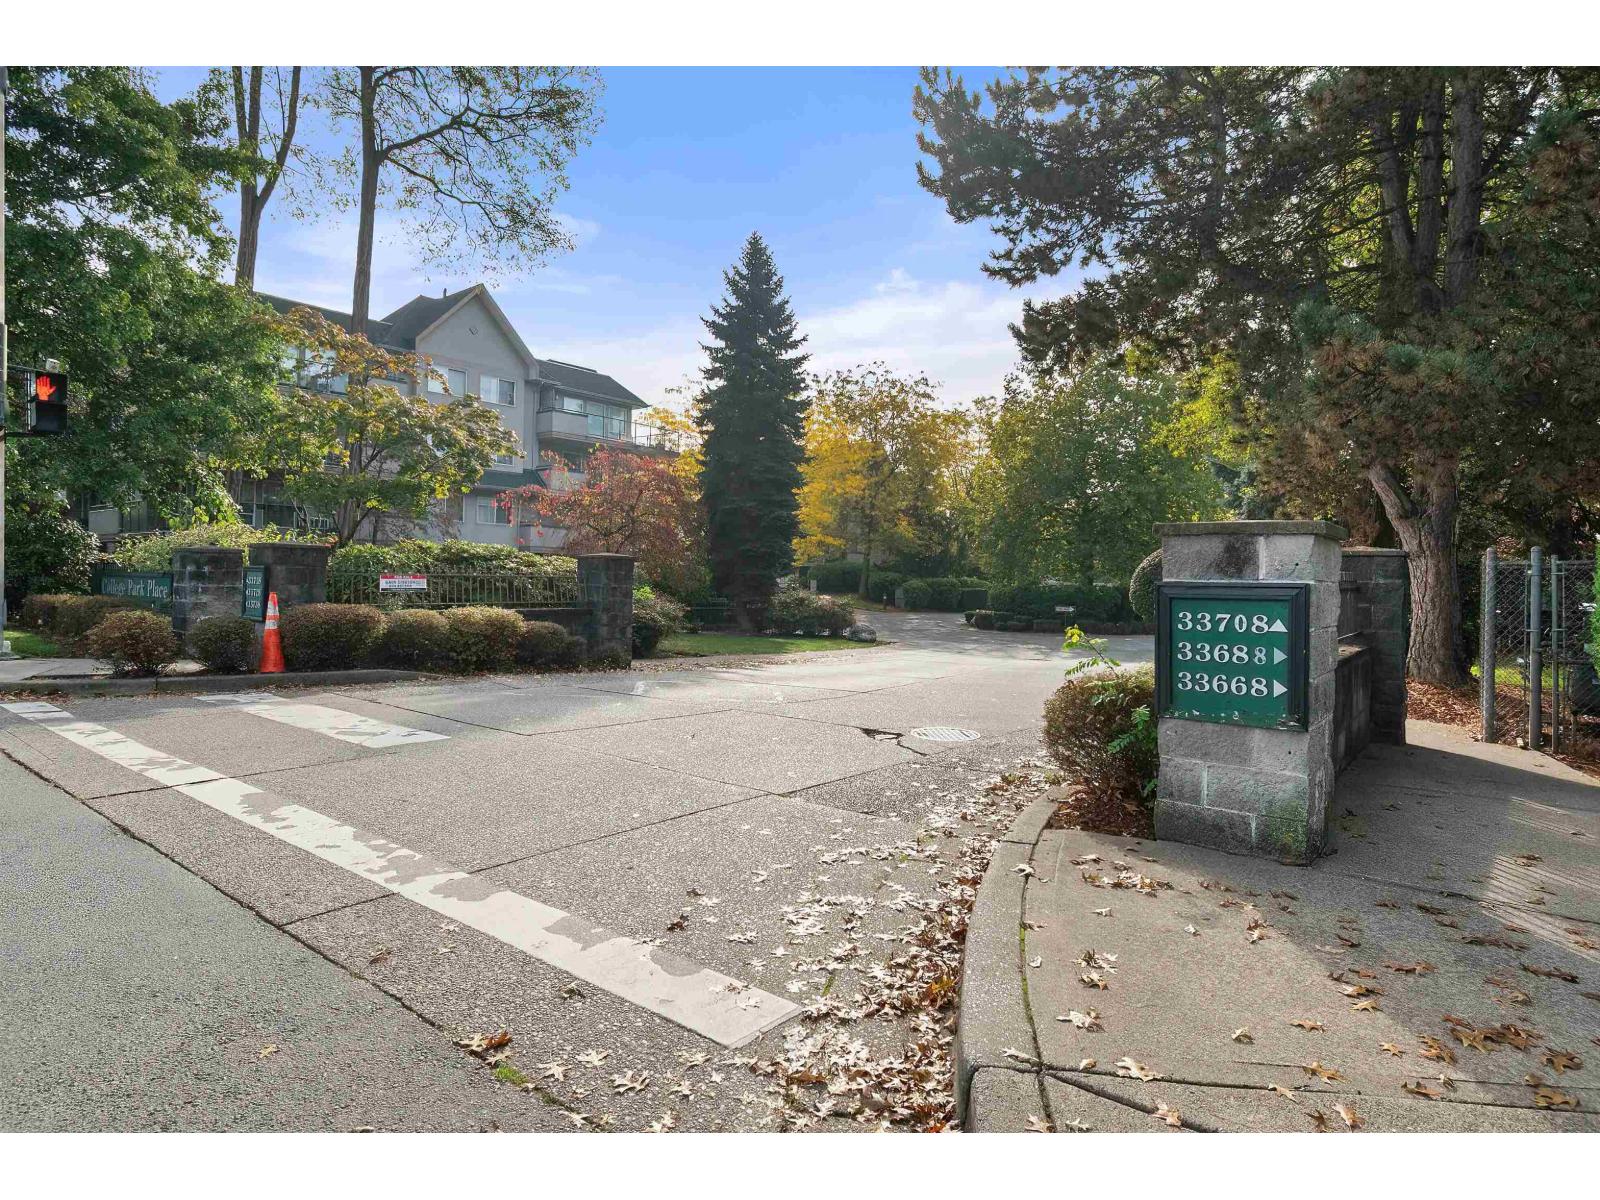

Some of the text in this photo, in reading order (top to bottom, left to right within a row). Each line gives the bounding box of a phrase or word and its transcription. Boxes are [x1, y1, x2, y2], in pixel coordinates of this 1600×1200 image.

[128, 579, 145, 596] Park
[147, 579, 168, 598] Place
[1177, 611, 1269, 634] 33708
[1177, 641, 1267, 665] 33688
[1177, 671, 1268, 697] 33668
